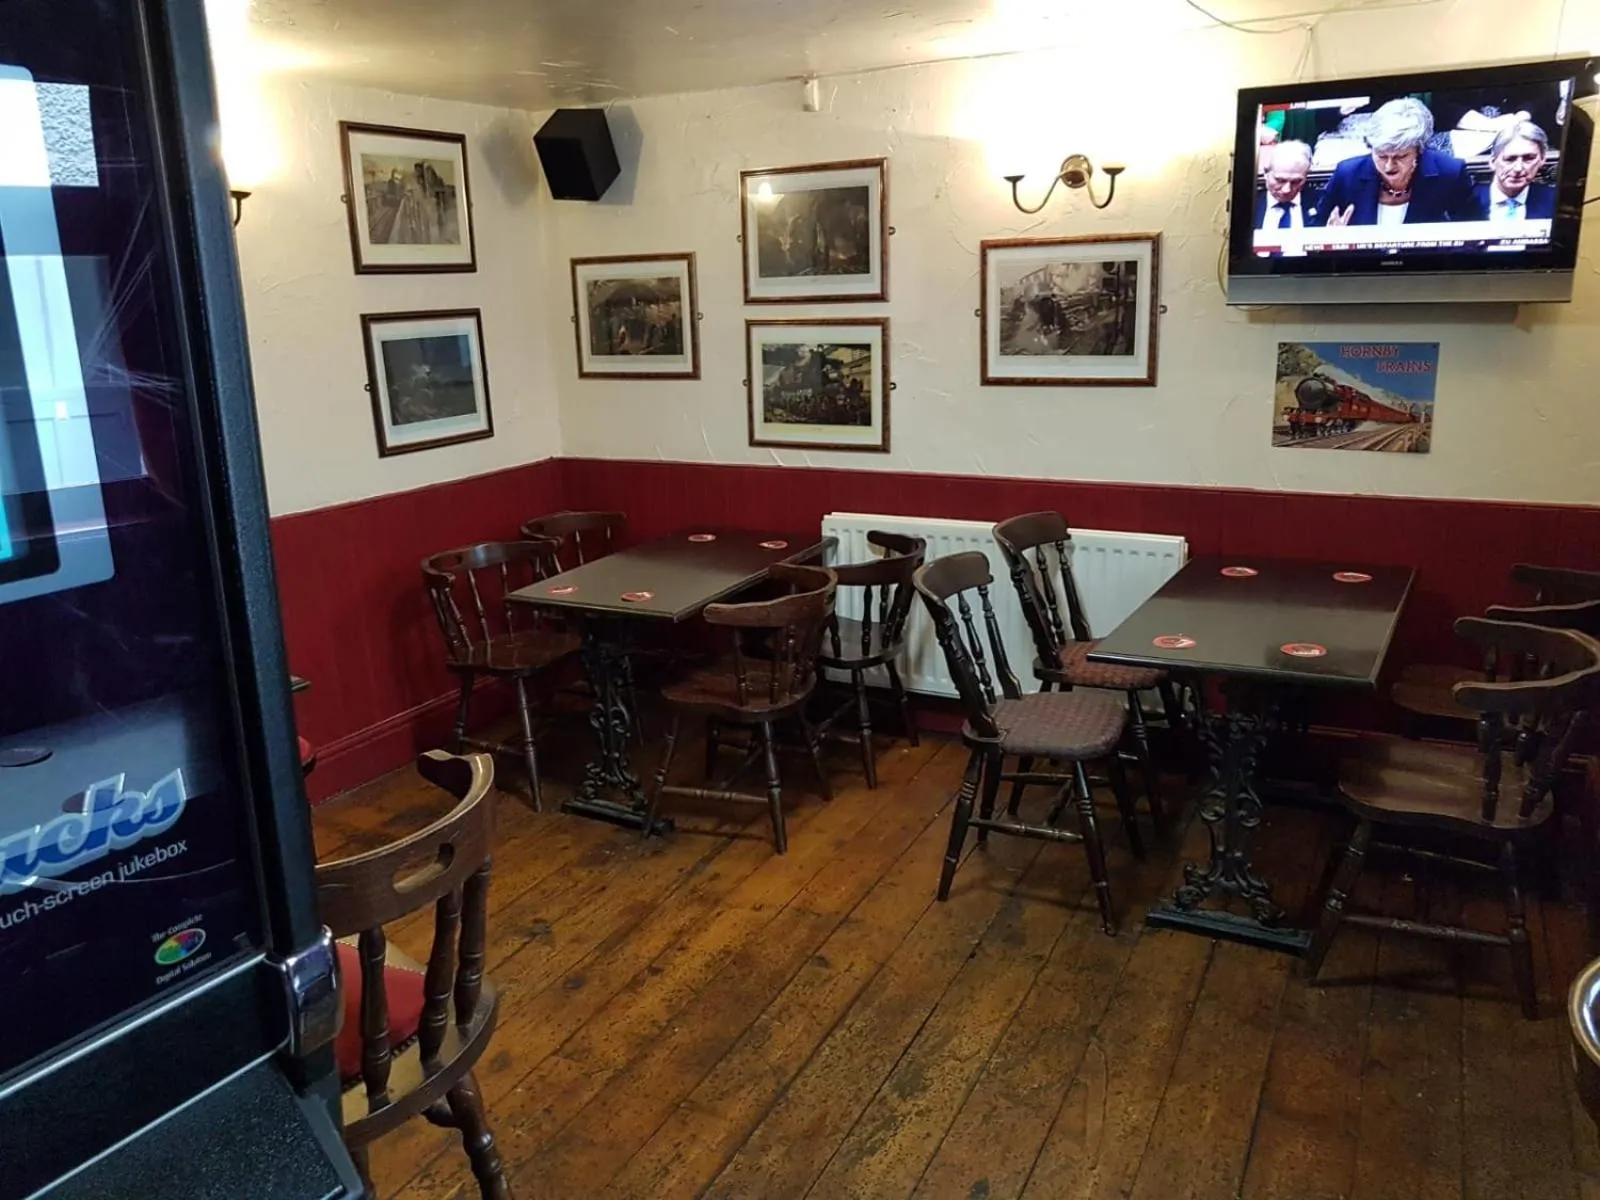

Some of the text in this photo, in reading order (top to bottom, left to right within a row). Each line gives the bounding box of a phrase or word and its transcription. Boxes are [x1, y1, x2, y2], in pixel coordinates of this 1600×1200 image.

[1339, 344, 1399, 359] HORNBY
[1376, 360, 1432, 374] TRAINS
[117, 839, 188, 883] jukebox
